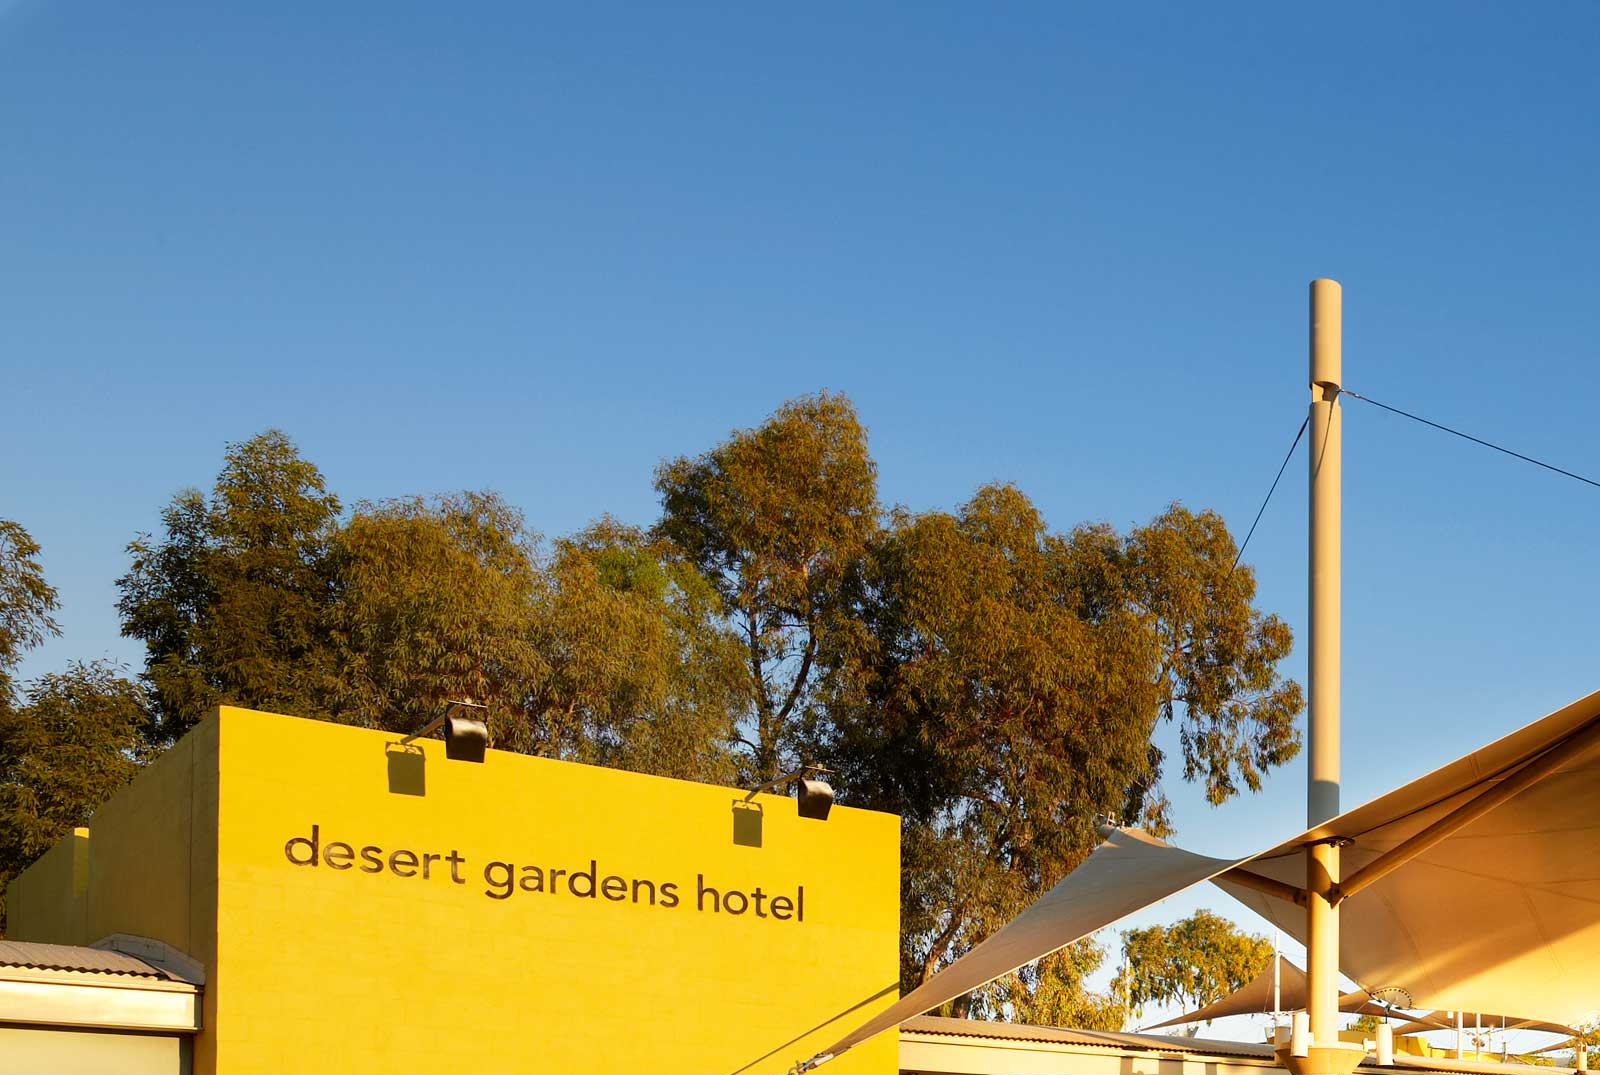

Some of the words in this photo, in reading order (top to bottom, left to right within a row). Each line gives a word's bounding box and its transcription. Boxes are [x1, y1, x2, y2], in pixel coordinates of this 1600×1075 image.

[285, 824, 467, 884] desert
[484, 860, 680, 908] gardens
[697, 874, 805, 922] hotel
